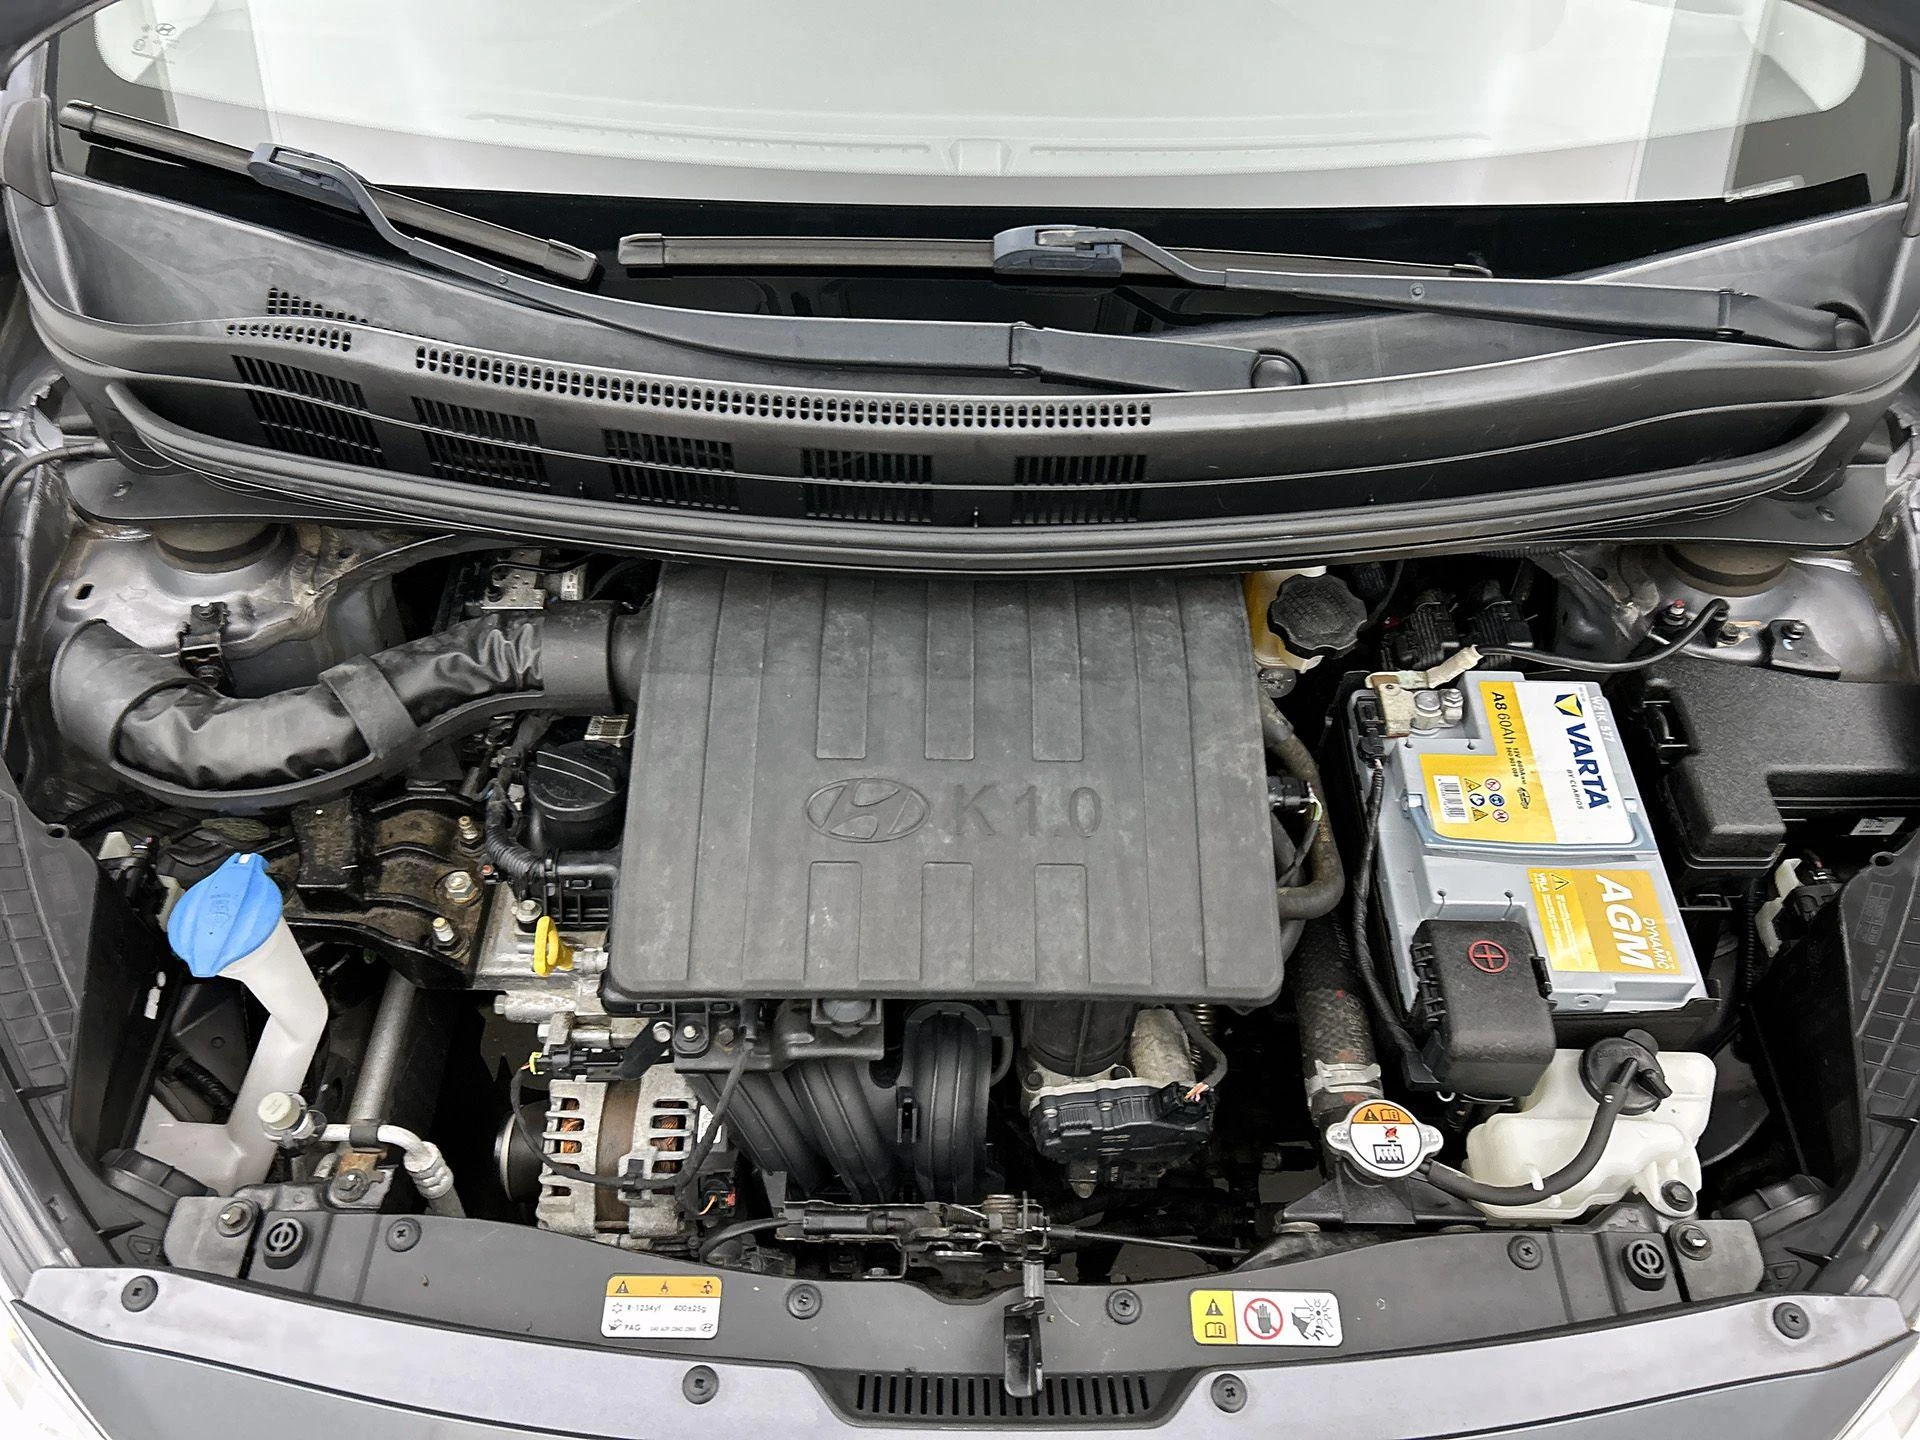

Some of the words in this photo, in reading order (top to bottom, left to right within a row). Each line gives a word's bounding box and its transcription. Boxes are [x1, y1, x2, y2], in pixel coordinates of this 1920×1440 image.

[1491, 691, 1508, 711] A8
[1497, 713, 1517, 745] 60Ah
[1566, 723, 1610, 809] VARTA
[1596, 874, 1655, 970] AGM
[1643, 917, 1670, 970] DYNAMIC
